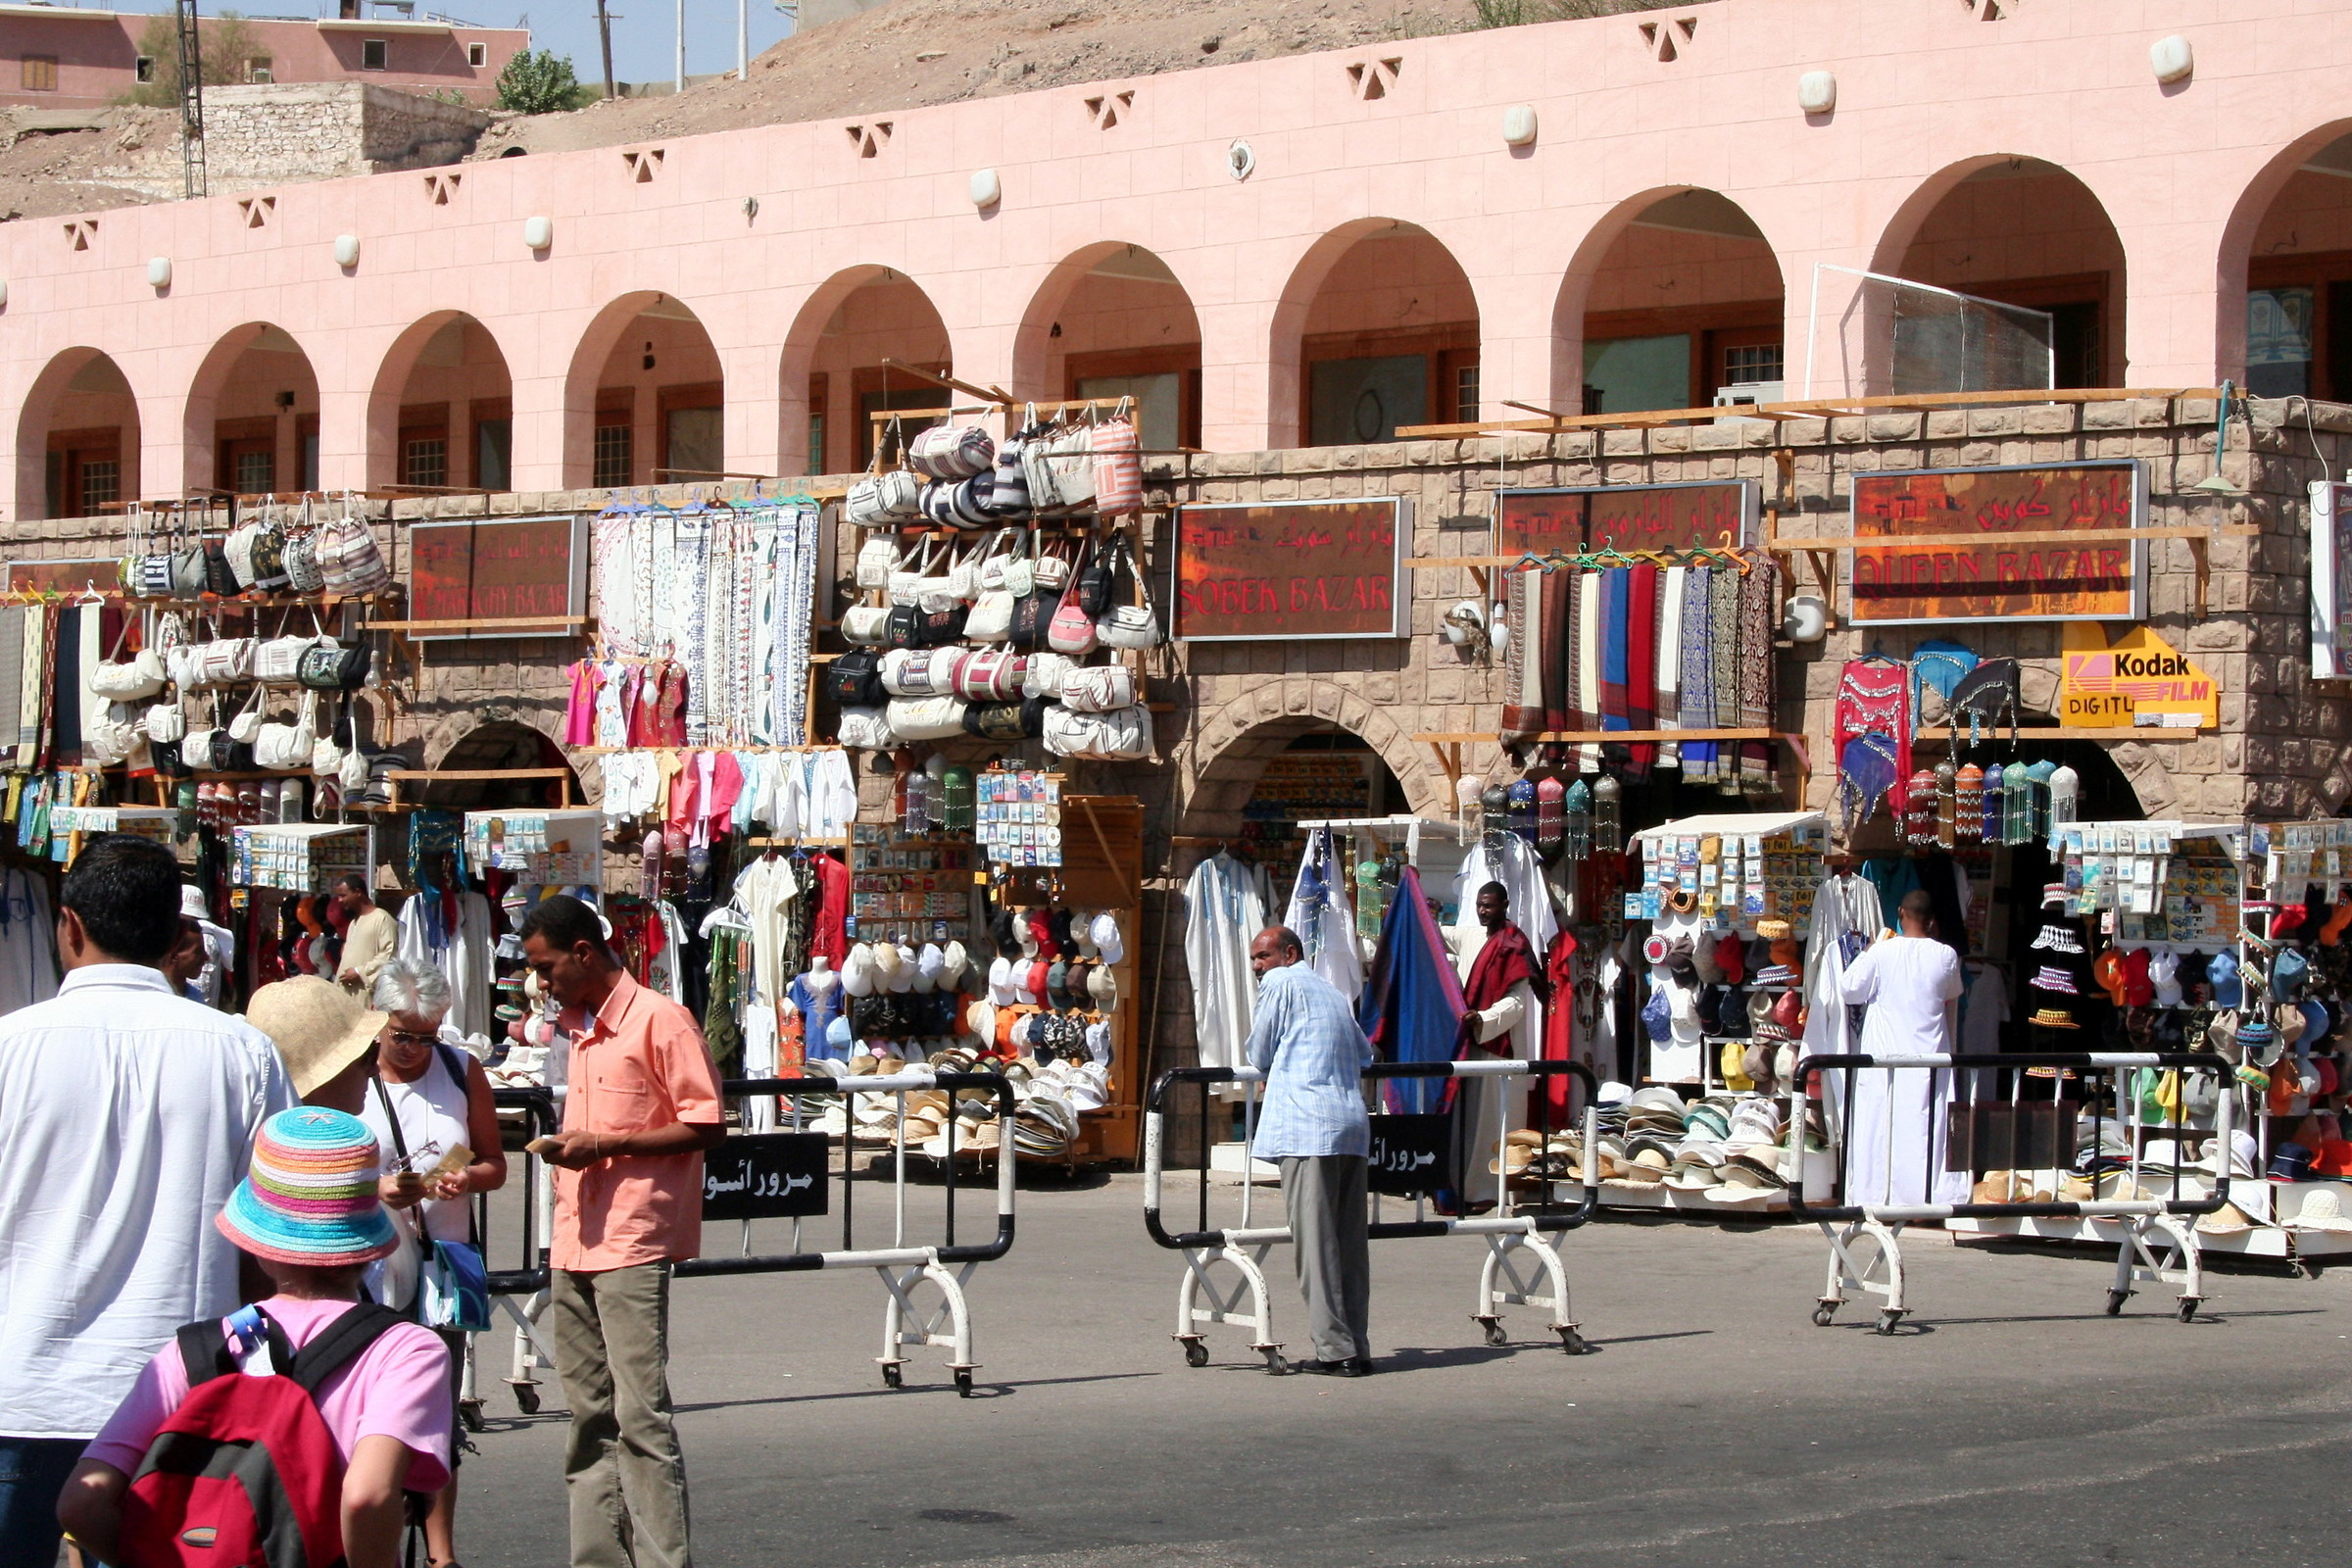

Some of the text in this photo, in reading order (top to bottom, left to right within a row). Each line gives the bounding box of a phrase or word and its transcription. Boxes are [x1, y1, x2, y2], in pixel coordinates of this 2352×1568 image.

[1977, 474, 2131, 532] بازار كوين
[1339, 511, 1394, 559] بازار
[1854, 549, 2127, 602] QUEEN BAZAR
[515, 583, 566, 614] BAZAR
[1179, 574, 1391, 616] SOBEK BAZAR
[2115, 653, 2190, 677] Kodak
[2070, 697, 2132, 714] DIGITL
[2156, 681, 2210, 702] FILM
[1386, 1149, 1437, 1172] مرور
[702, 1159, 813, 1200] مرور أسوا
